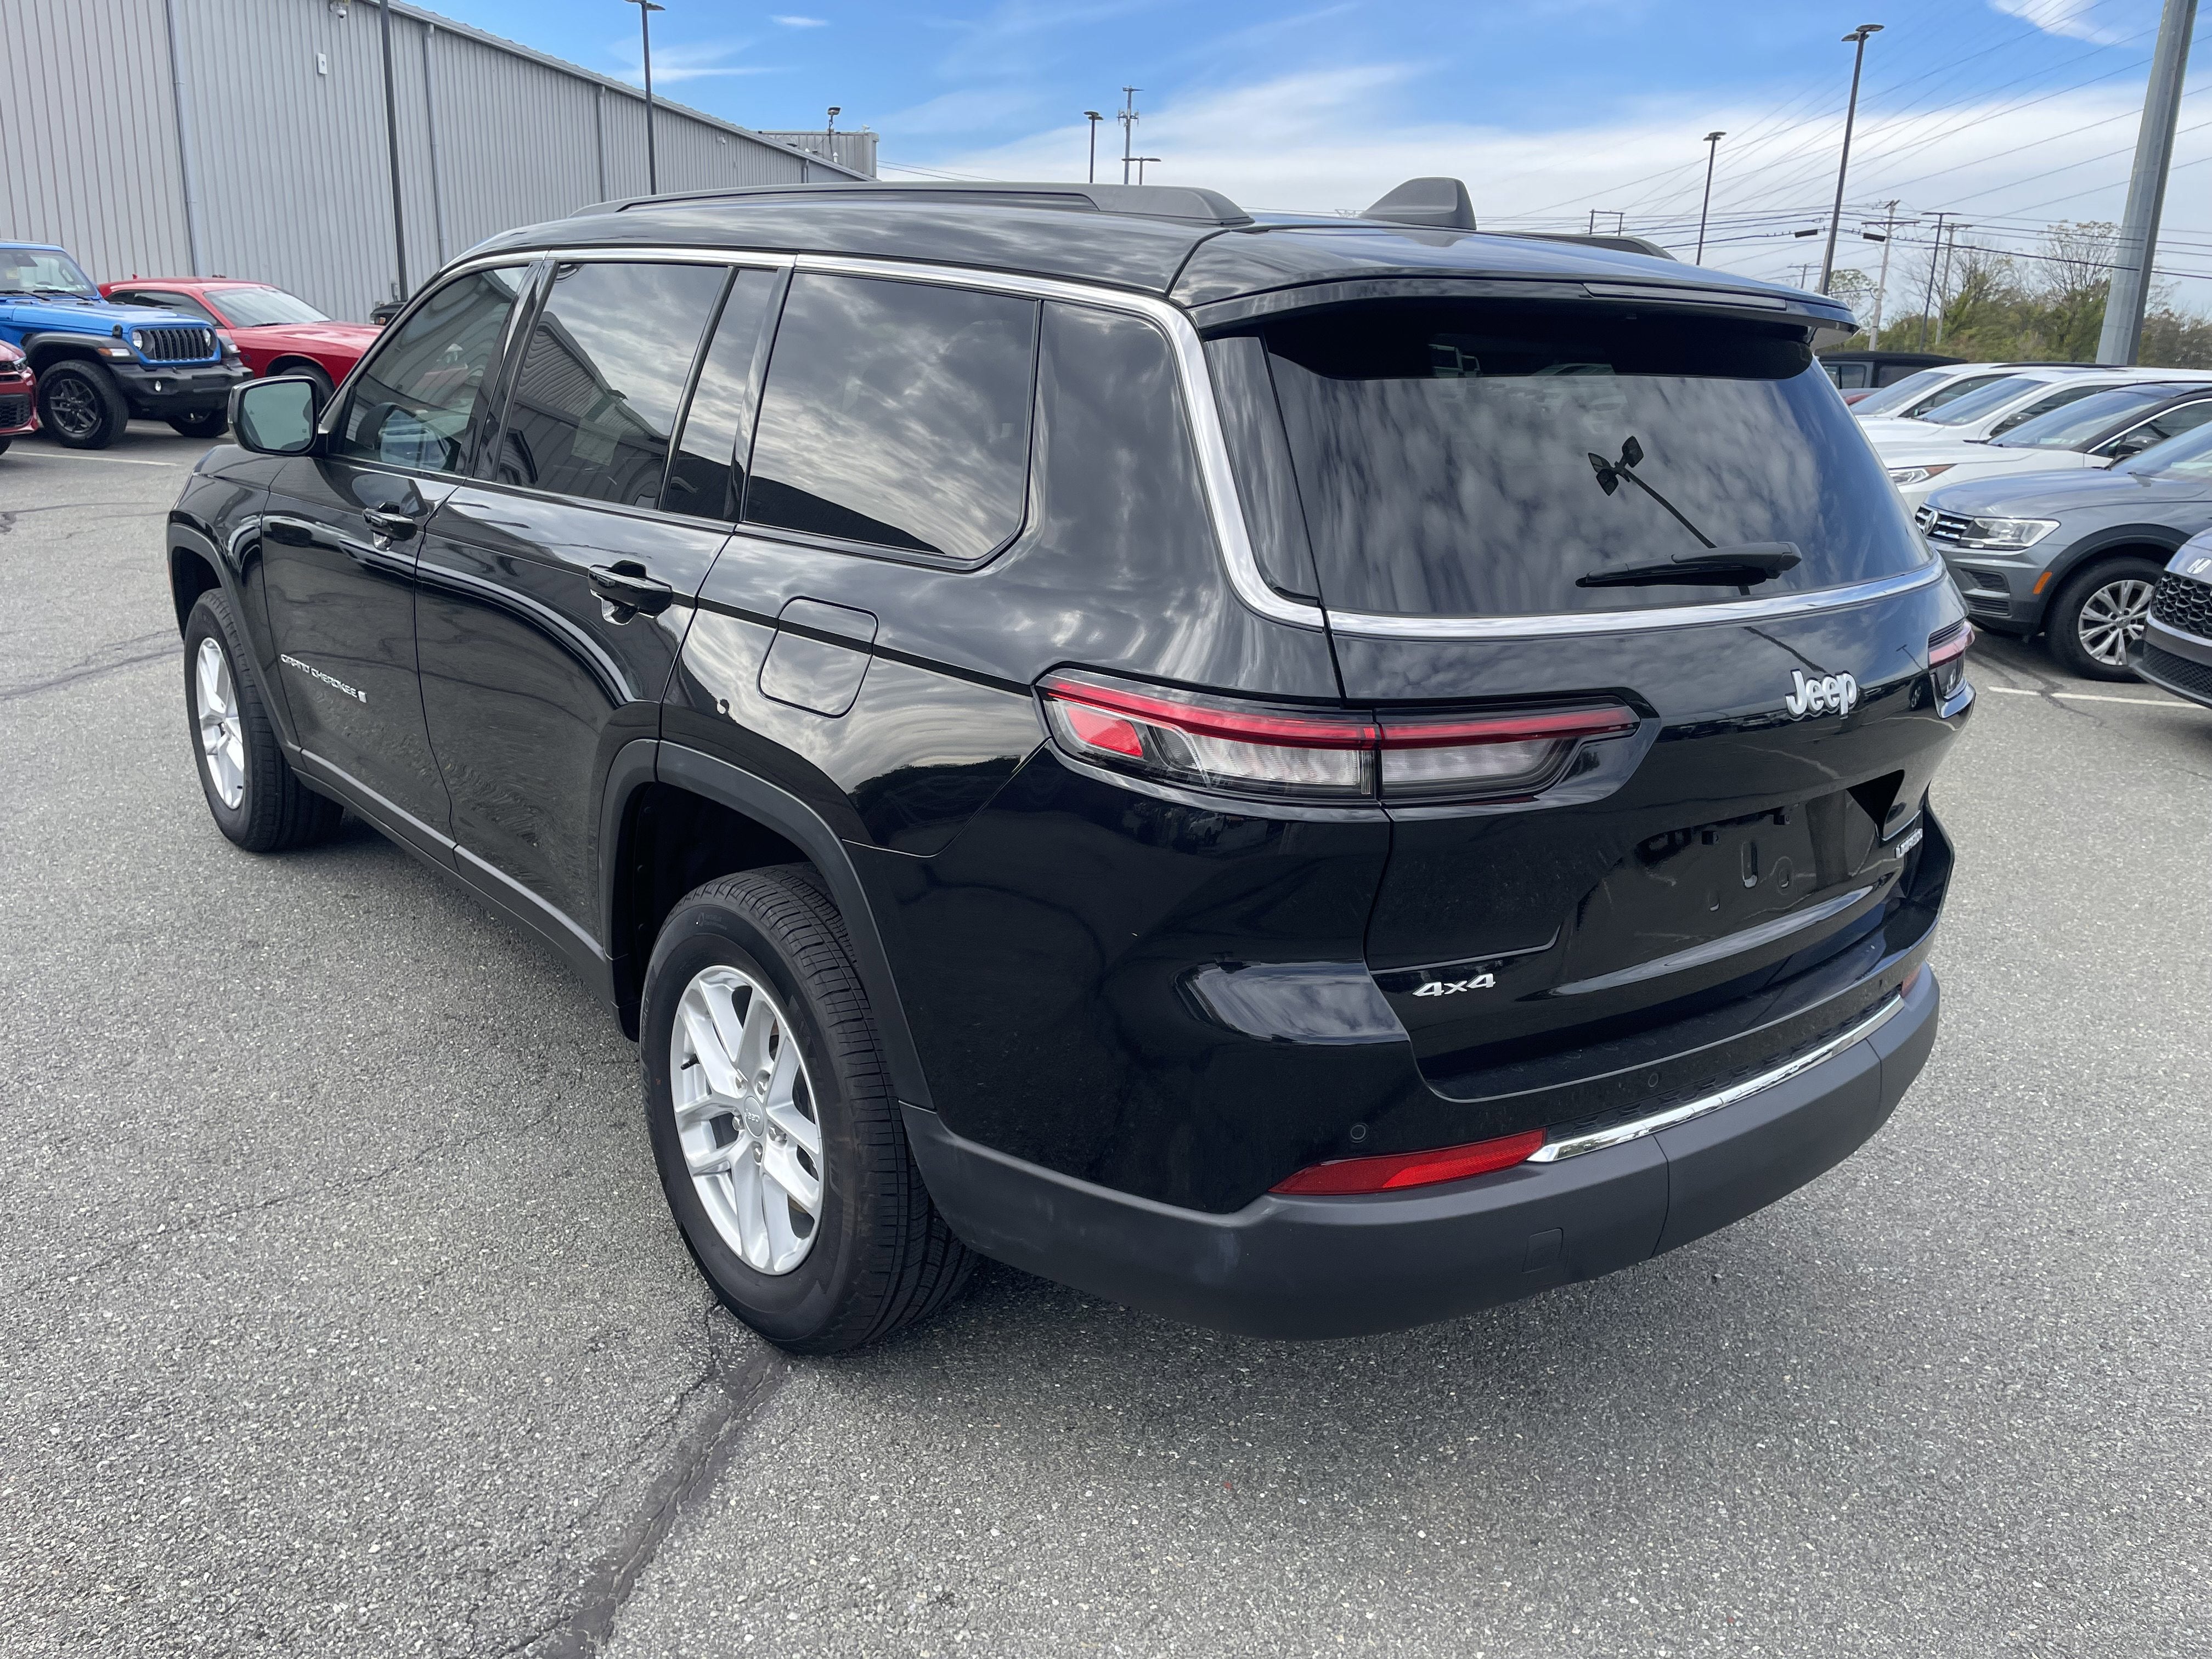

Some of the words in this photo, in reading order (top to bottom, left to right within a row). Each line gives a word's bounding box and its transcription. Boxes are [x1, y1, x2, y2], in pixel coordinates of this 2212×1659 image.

[311, 668, 358, 698] CHEROKEE
[1785, 669, 1858, 716] Jeep
[1412, 973, 1496, 997] 4x4
